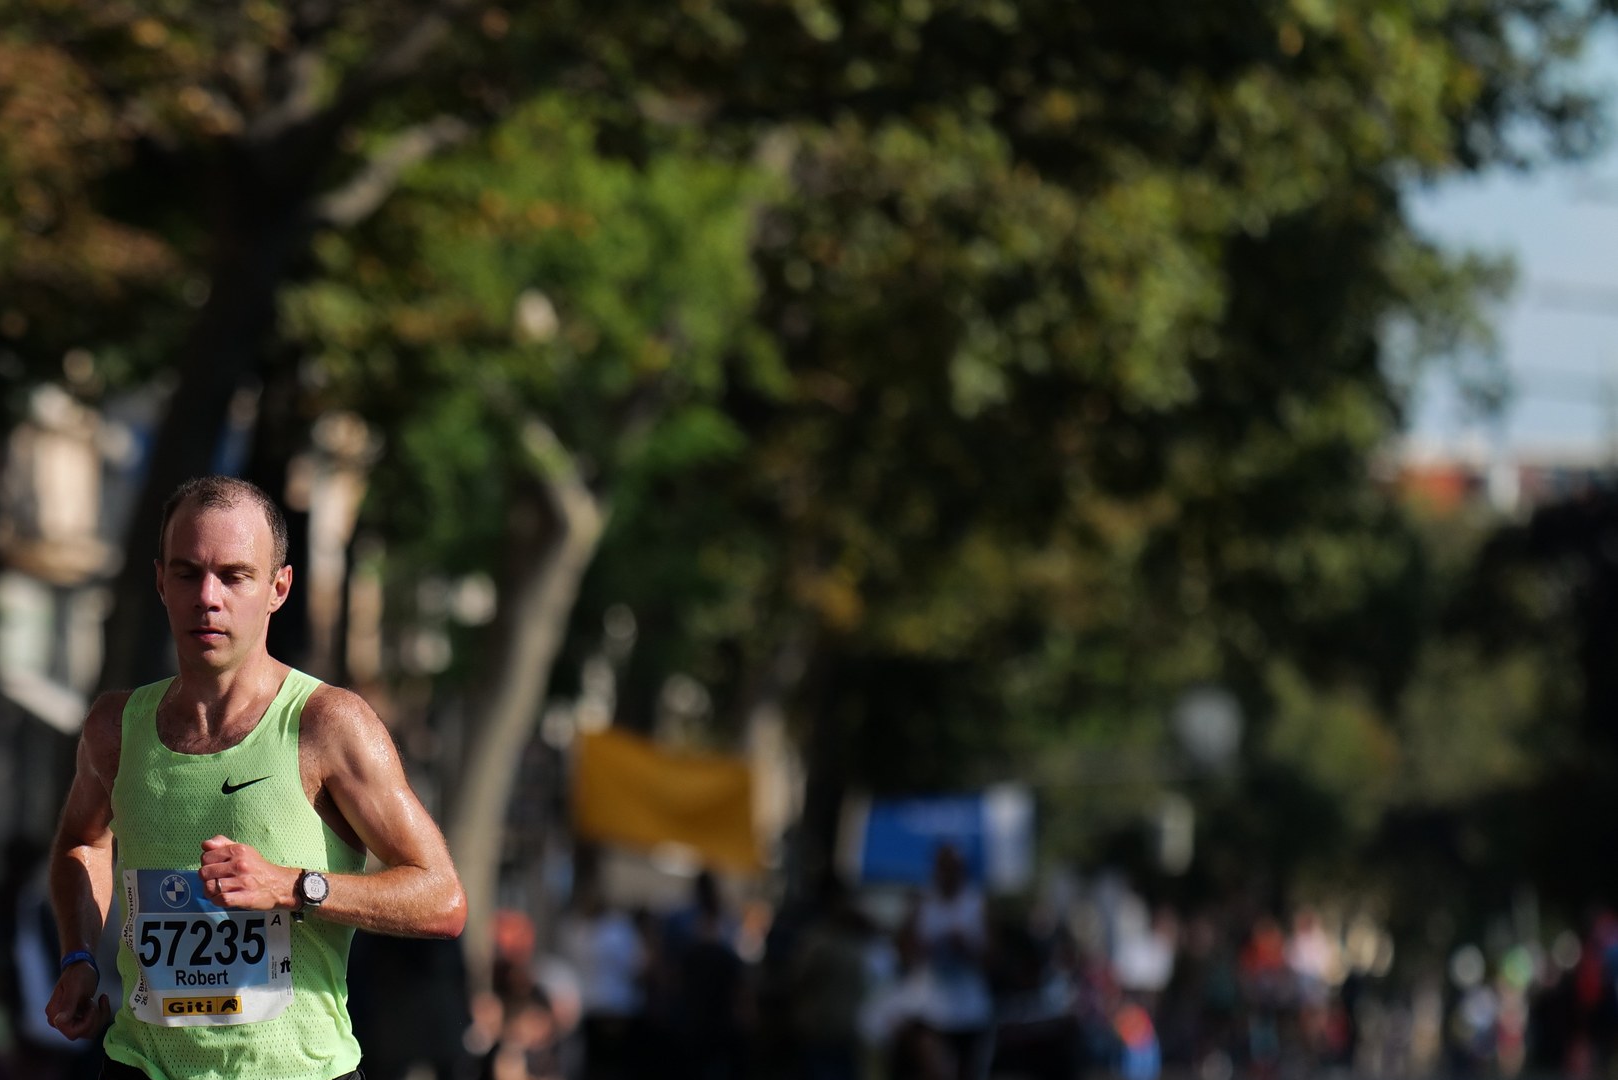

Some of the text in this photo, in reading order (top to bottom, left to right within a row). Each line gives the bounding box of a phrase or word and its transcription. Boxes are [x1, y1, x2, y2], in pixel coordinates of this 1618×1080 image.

[271, 913, 282, 926] A
[138, 919, 266, 968] 57235
[175, 969, 229, 986] Robert
[168, 999, 213, 1013] Giti
